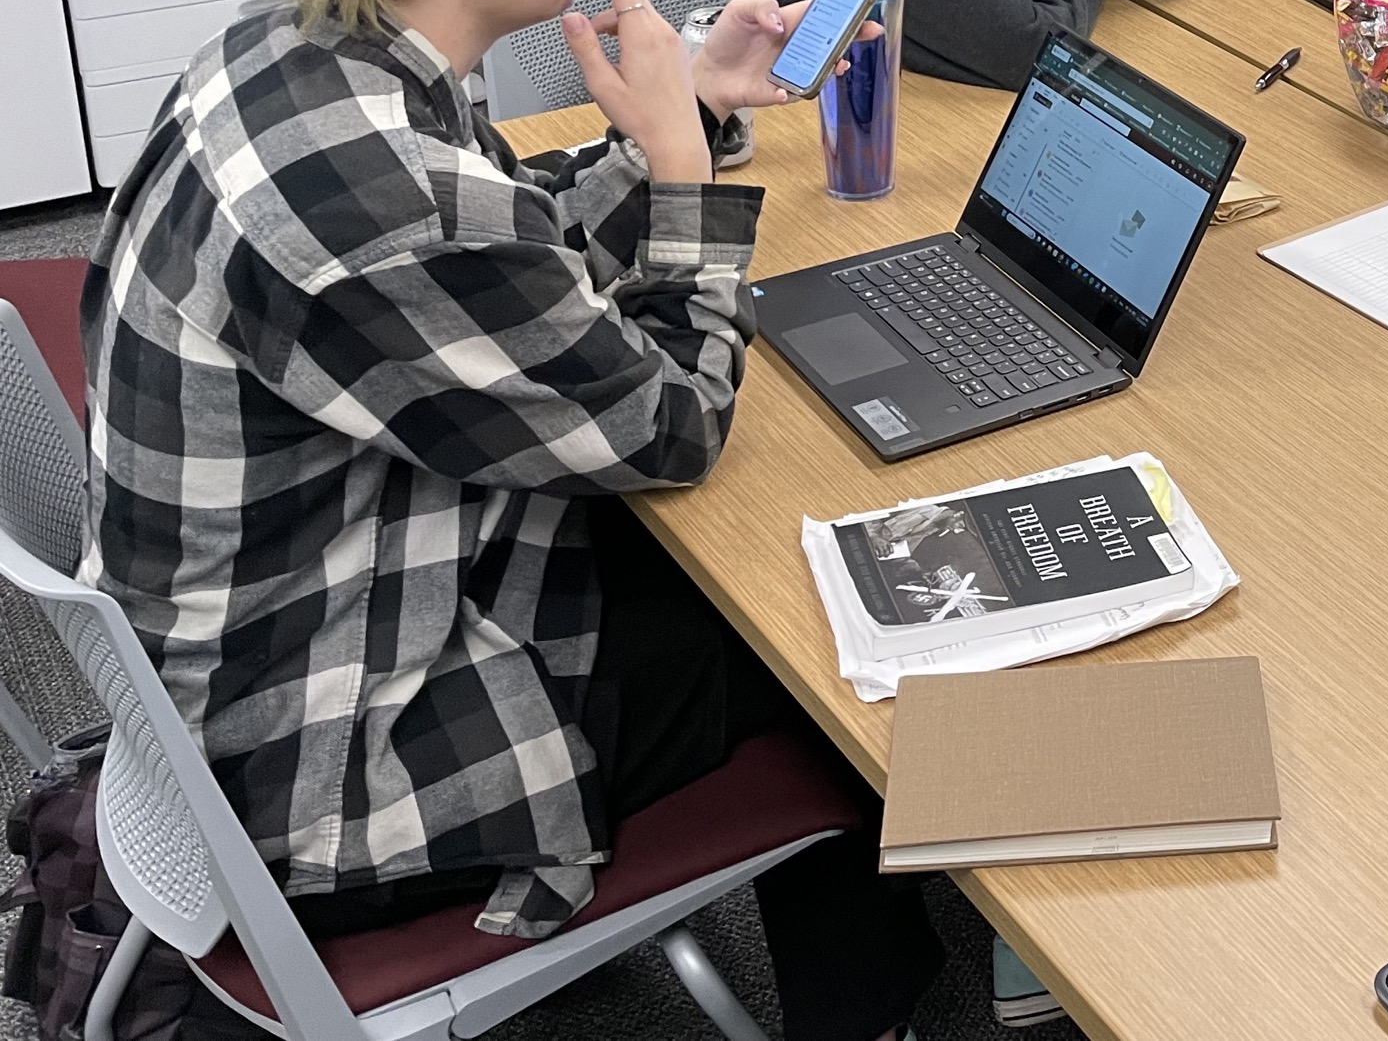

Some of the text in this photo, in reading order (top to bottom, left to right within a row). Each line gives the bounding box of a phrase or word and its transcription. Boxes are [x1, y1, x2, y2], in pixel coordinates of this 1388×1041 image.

[1006, 503, 1068, 582] FREEDOM
[1055, 523, 1089, 544] OF
[1079, 494, 1136, 561] BREATH
[1126, 515, 1155, 529] A
